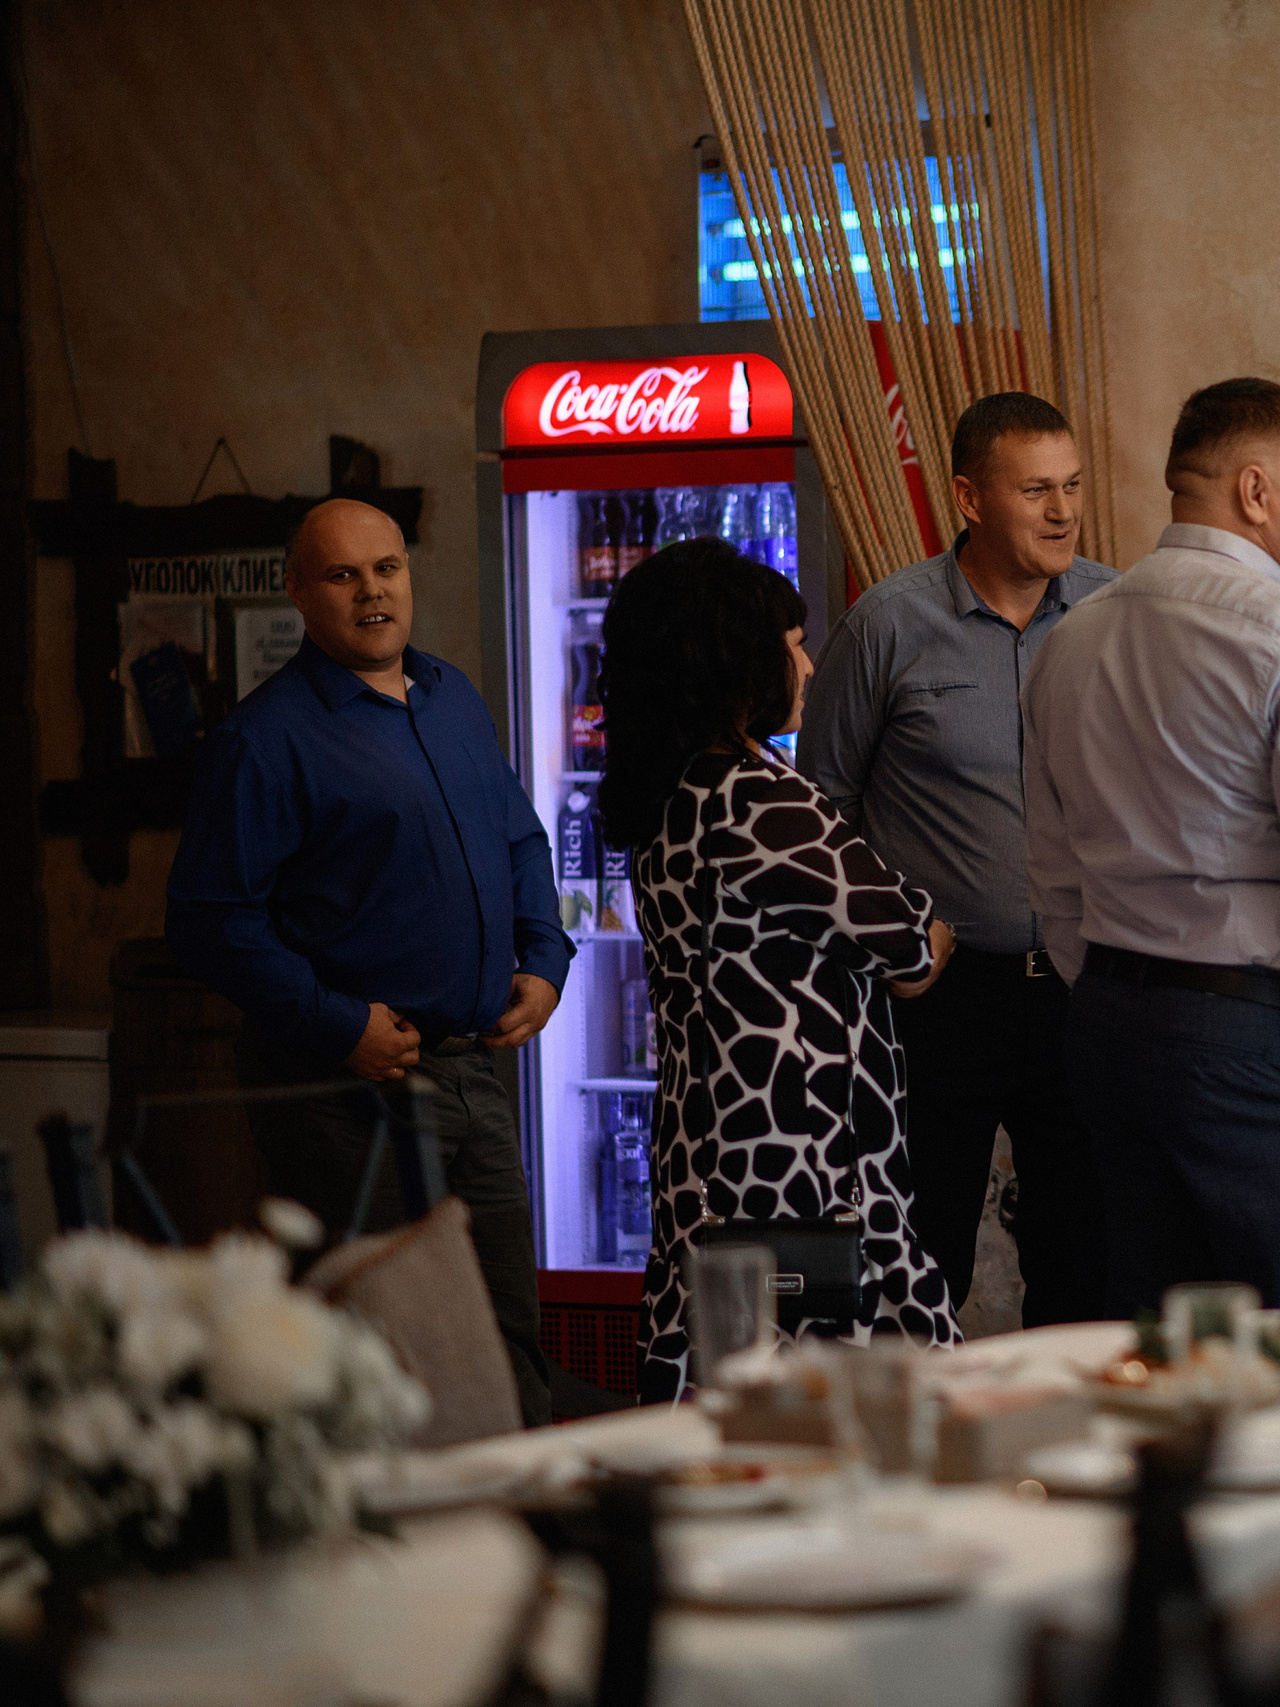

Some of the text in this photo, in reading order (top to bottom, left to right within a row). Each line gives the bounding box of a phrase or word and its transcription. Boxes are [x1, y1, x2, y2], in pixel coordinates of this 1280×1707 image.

[539, 365, 710, 438] Coca-Cola
[131, 558, 287, 594] УГОЛОК КЛИЕ
[564, 819, 583, 877] Rich
[606, 850, 626, 878] Ri
